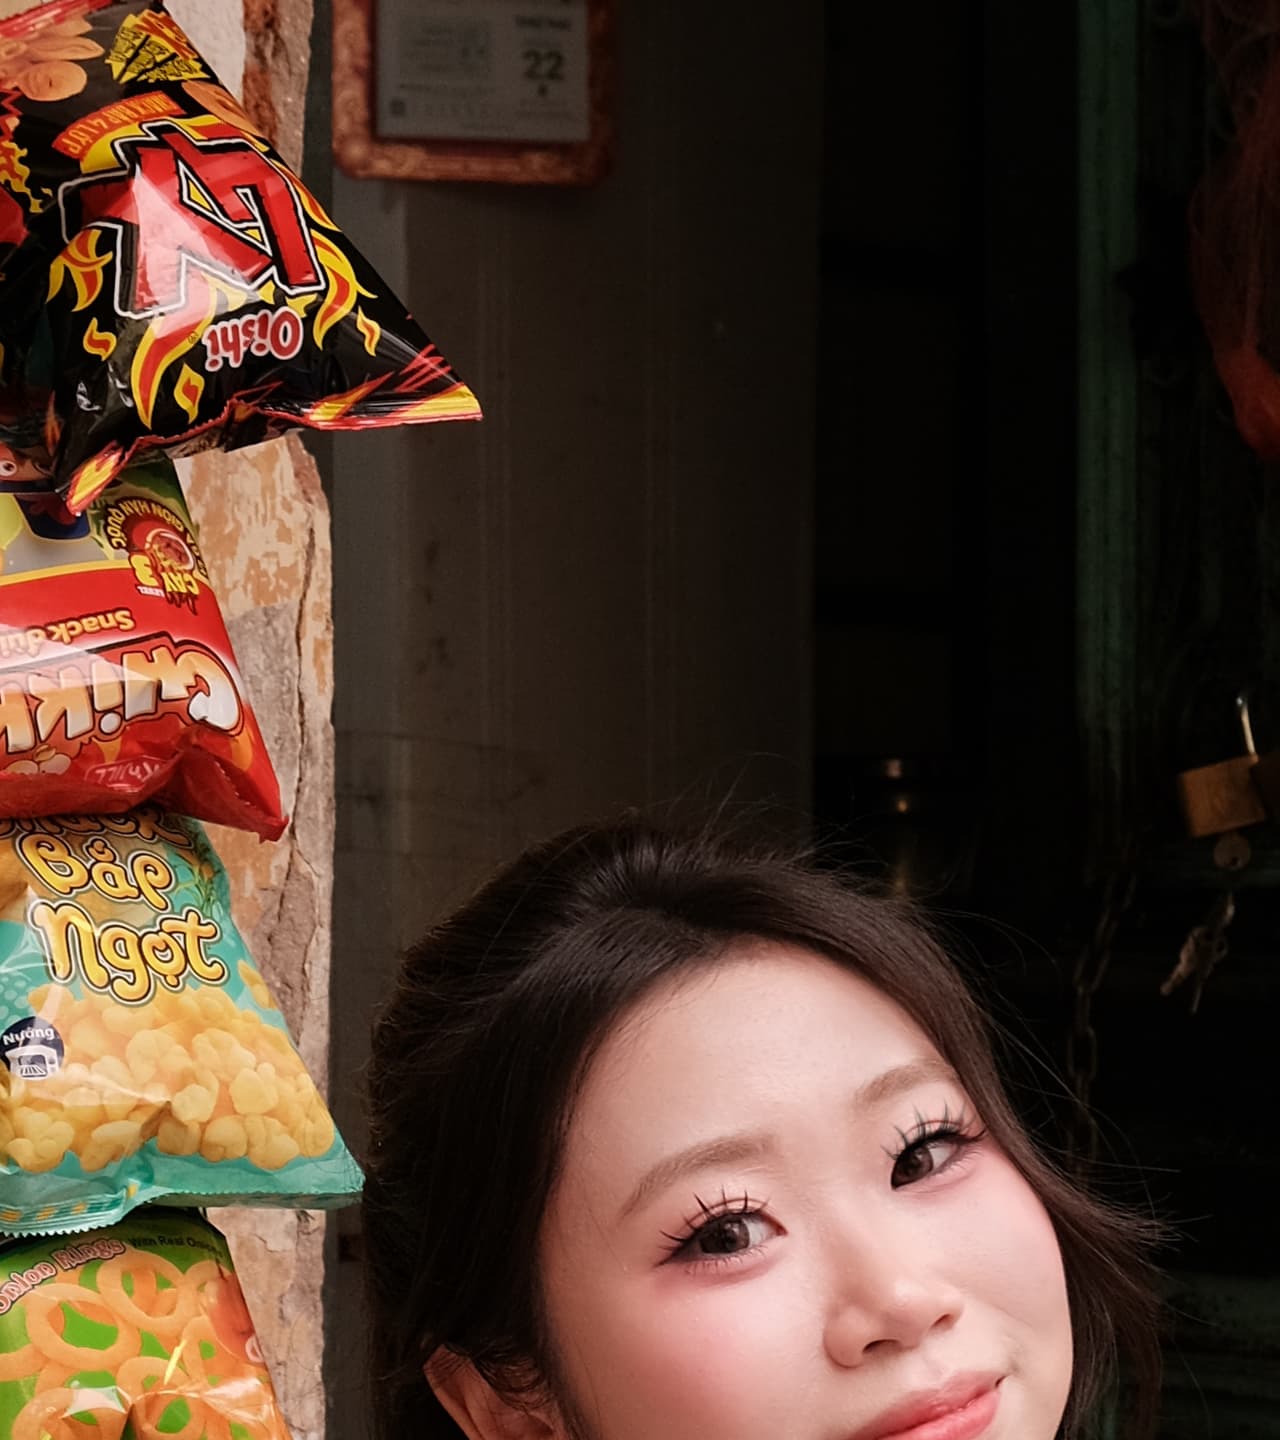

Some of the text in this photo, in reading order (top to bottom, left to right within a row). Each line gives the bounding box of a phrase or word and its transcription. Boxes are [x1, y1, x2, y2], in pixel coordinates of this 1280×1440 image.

[523, 50, 565, 81] 22
[204, 307, 304, 372] Oishi
[131, 554, 160, 586] 3
[160, 570, 201, 596] CAY
[0, 627, 49, 656] đùi
[48, 608, 136, 646] Snack
[2, 1025, 56, 1046] Nướng
[52, 1237, 127, 1270] Rings
